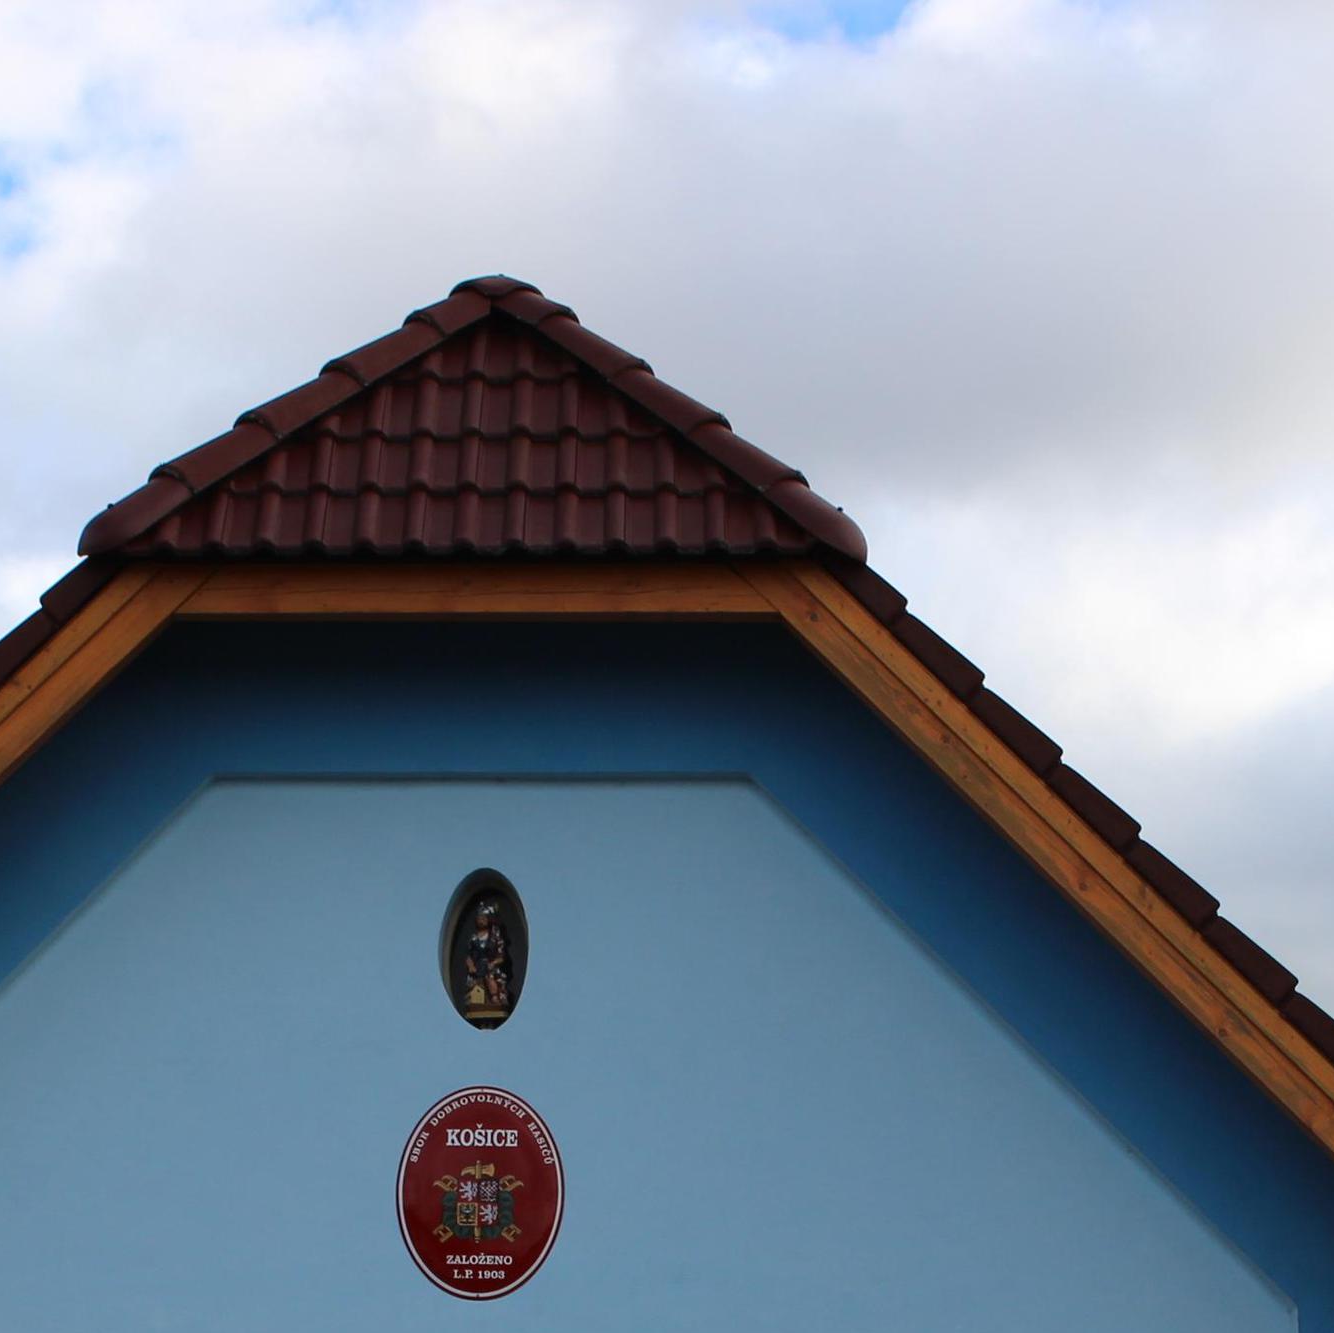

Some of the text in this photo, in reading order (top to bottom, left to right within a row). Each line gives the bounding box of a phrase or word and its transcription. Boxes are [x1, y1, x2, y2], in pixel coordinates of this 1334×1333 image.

[446, 1123, 518, 1147] KOŠICE
[410, 1131, 430, 1163] SBOR
[446, 1253, 513, 1265] ZALOŽENO
[453, 1269, 505, 1279] L.P. 1903
